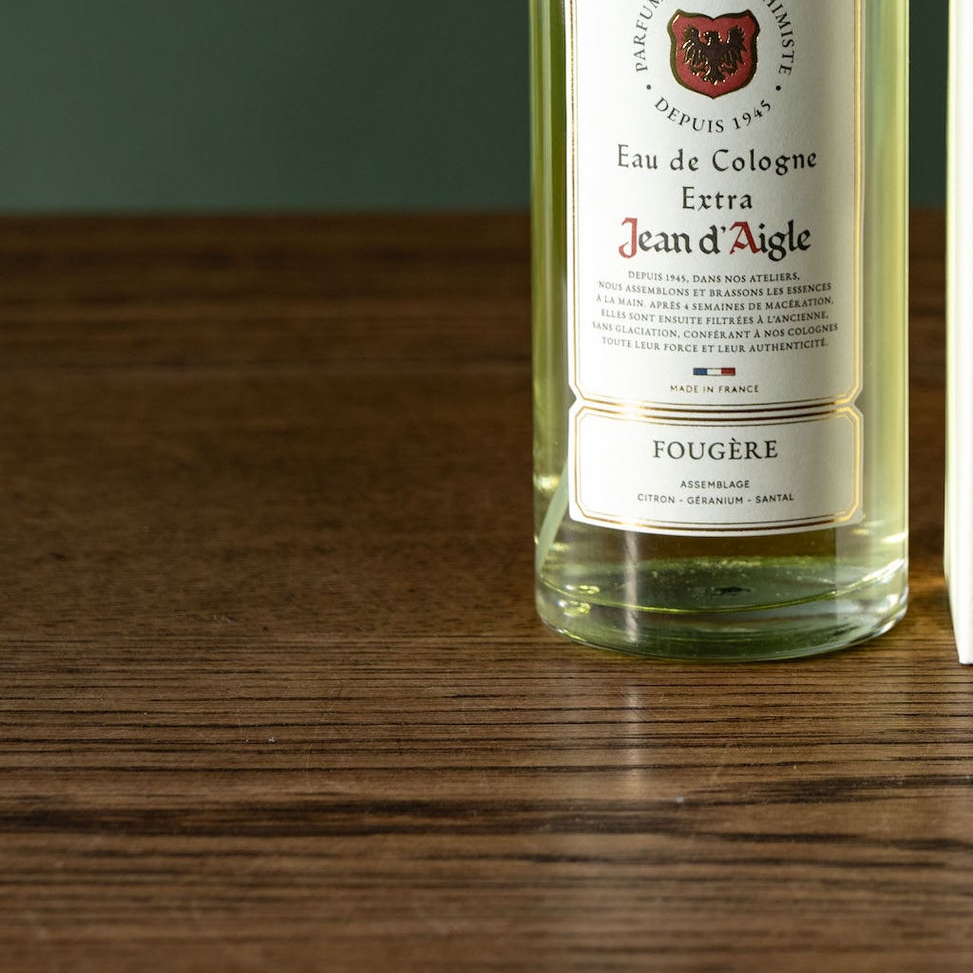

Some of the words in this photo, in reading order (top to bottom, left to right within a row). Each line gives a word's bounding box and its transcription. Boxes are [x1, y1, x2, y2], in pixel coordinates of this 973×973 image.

[655, 97, 724, 133] DEPUIS
[733, 100, 771, 129] 1945
[618, 144, 657, 169] Eau
[670, 149, 698, 171] de
[712, 149, 817, 175] Cologne
[682, 187, 752, 210] Extra
[619, 217, 692, 258] Jean
[628, 271, 663, 281] DEPUIS
[666, 274, 689, 283] 1945,
[693, 275, 722, 283] DANS
[725, 275, 746, 283] NOS
[750, 272, 800, 283] ATELIERS,
[599, 281, 622, 291] NOUS
[626, 285, 689, 296] ASSEMBLONS
[693, 288, 705, 296] ET
[709, 288, 763, 297] BRASSONS
[767, 287, 784, 296] LES
[787, 283, 832, 295] ESSENCES
[604, 296, 615, 304] LA
[619, 298, 646, 308] MAIN.
[650, 299, 681, 309] APRÈS
[692, 303, 745, 311] SEMAINES
[749, 303, 762, 311] DE
[765, 297, 834, 310] MACÉRATION,
[601, 310, 626, 319] ELLES
[629, 312, 655, 322] SONT
[659, 315, 702, 324] ENSUITE
[707, 315, 753, 325] FILTRÉES
[757, 314, 764, 324] À
[768, 311, 829, 323] L'ANCIENNE,
[592, 322, 613, 331] SANS
[616, 324, 680, 338] GLACIATION,
[684, 328, 750, 339] CONFÉRANT
[754, 328, 760, 338] À
[765, 328, 784, 337] NOS
[788, 323, 838, 336] COLOGNES
[602, 337, 631, 348] TOUTE
[635, 341, 660, 350] LEUR
[664, 343, 698, 352] FORCE
[702, 344, 714, 352] ET
[718, 344, 746, 352] LEUR
[749, 338, 828, 352] AUTHENTICITÉ.
[670, 385, 699, 393] MADE
[719, 385, 759, 393] FRANCE
[653, 438, 778, 460] FOUGÈRE
[680, 480, 750, 488] ASSEMBLAGE
[637, 494, 675, 503] CITRON
[687, 495, 743, 504] GÉRANIUM
[755, 493, 794, 503] SANTAL
